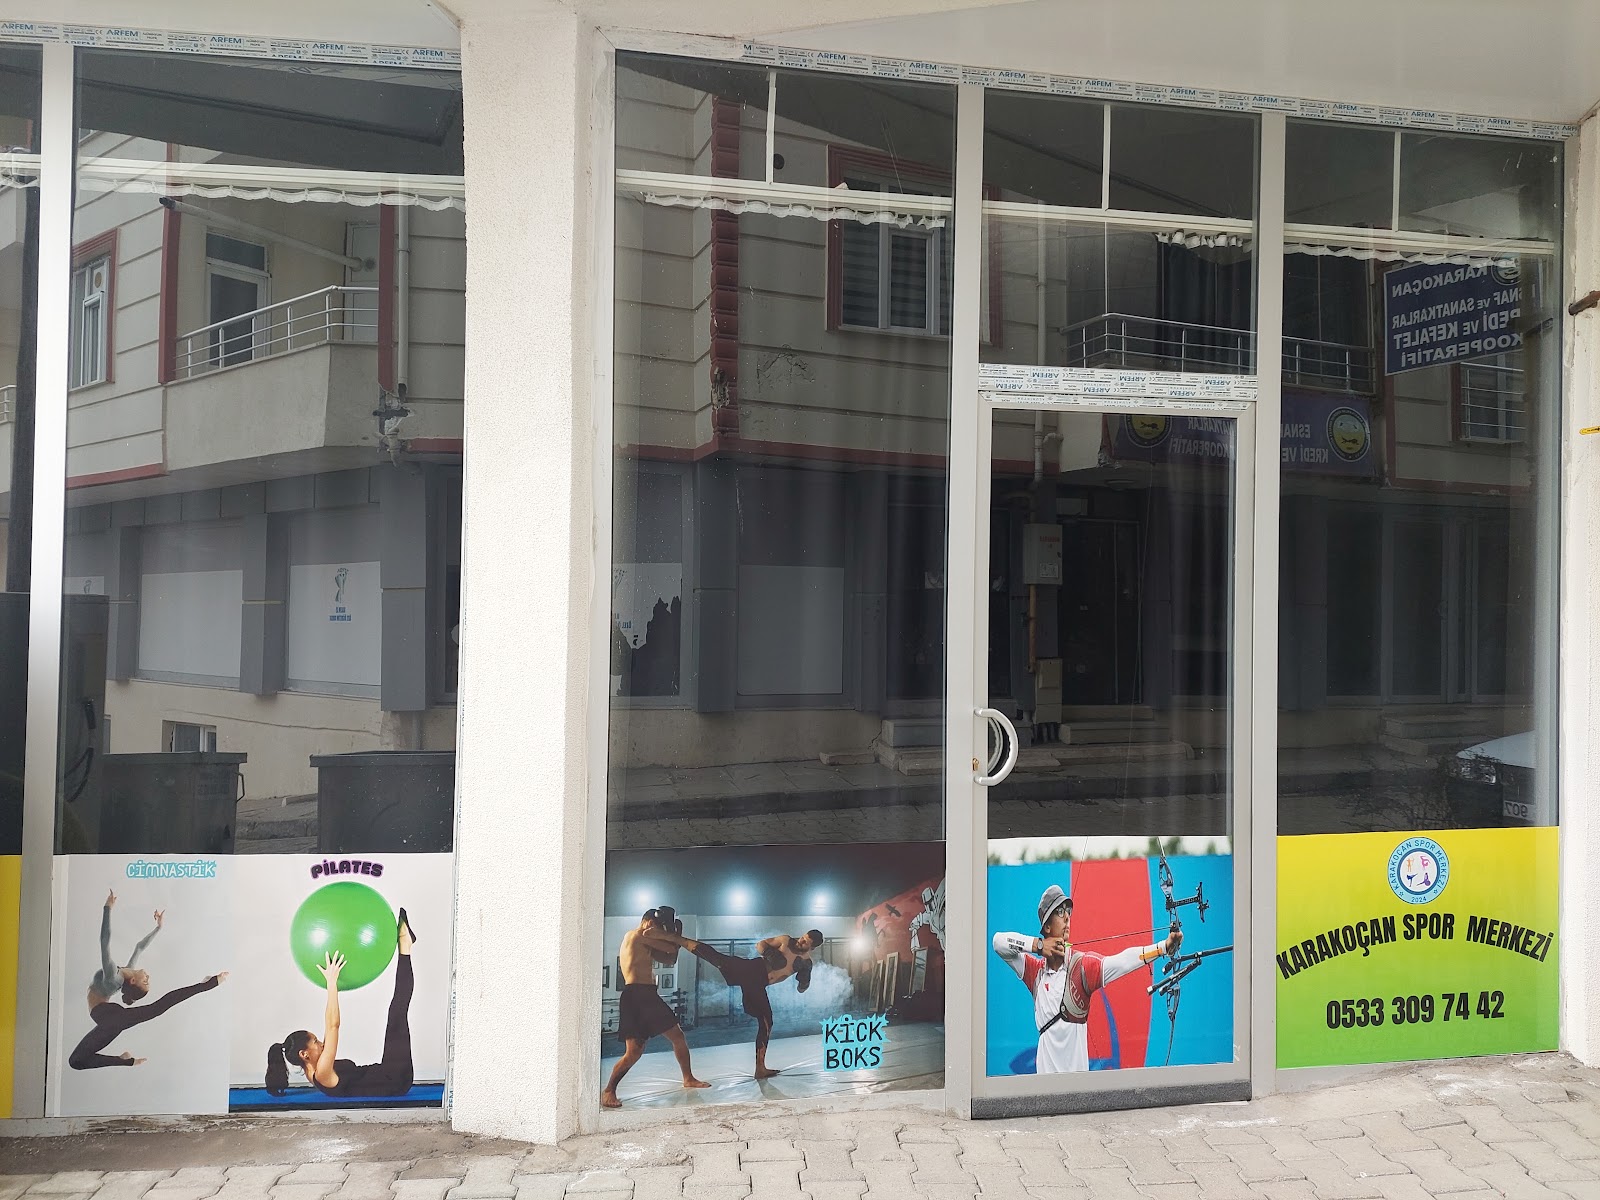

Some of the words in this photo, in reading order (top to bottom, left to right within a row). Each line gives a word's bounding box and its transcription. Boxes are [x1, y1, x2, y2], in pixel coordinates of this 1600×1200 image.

[106, 29, 139, 37] ARFEM
[210, 36, 242, 44] ARFEM
[312, 43, 344, 51] ARFEM
[412, 49, 444, 57] ARFEM
[817, 52, 846, 60] ARFEM
[909, 62, 937, 70] ARFEM
[998, 71, 1026, 79] ARFEM
[1085, 79, 1112, 87] ARFEM
[1169, 87, 1196, 95] ARFEM
[1252, 95, 1278, 104] ARFEM
[1332, 103, 1358, 111] ARFEM
[1410, 111, 1435, 119] ARFEM
[1487, 118, 1511, 126] ARFEM
[1414, 839, 1436, 851] SPOR
[310, 859, 384, 879] PİLATES
[1276, 915, 1397, 979] KARAKOÇAN
[1402, 913, 1455, 940] SPOR
[1466, 915, 1555, 963] MERKEZİ
[1326, 998, 1385, 1029] 0533
[1391, 995, 1435, 1025] 309
[1441, 992, 1470, 1021] 74
[1476, 990, 1505, 1018] 42
[825, 1016, 883, 1044] KİCK
[826, 1046, 881, 1069] BOKS
